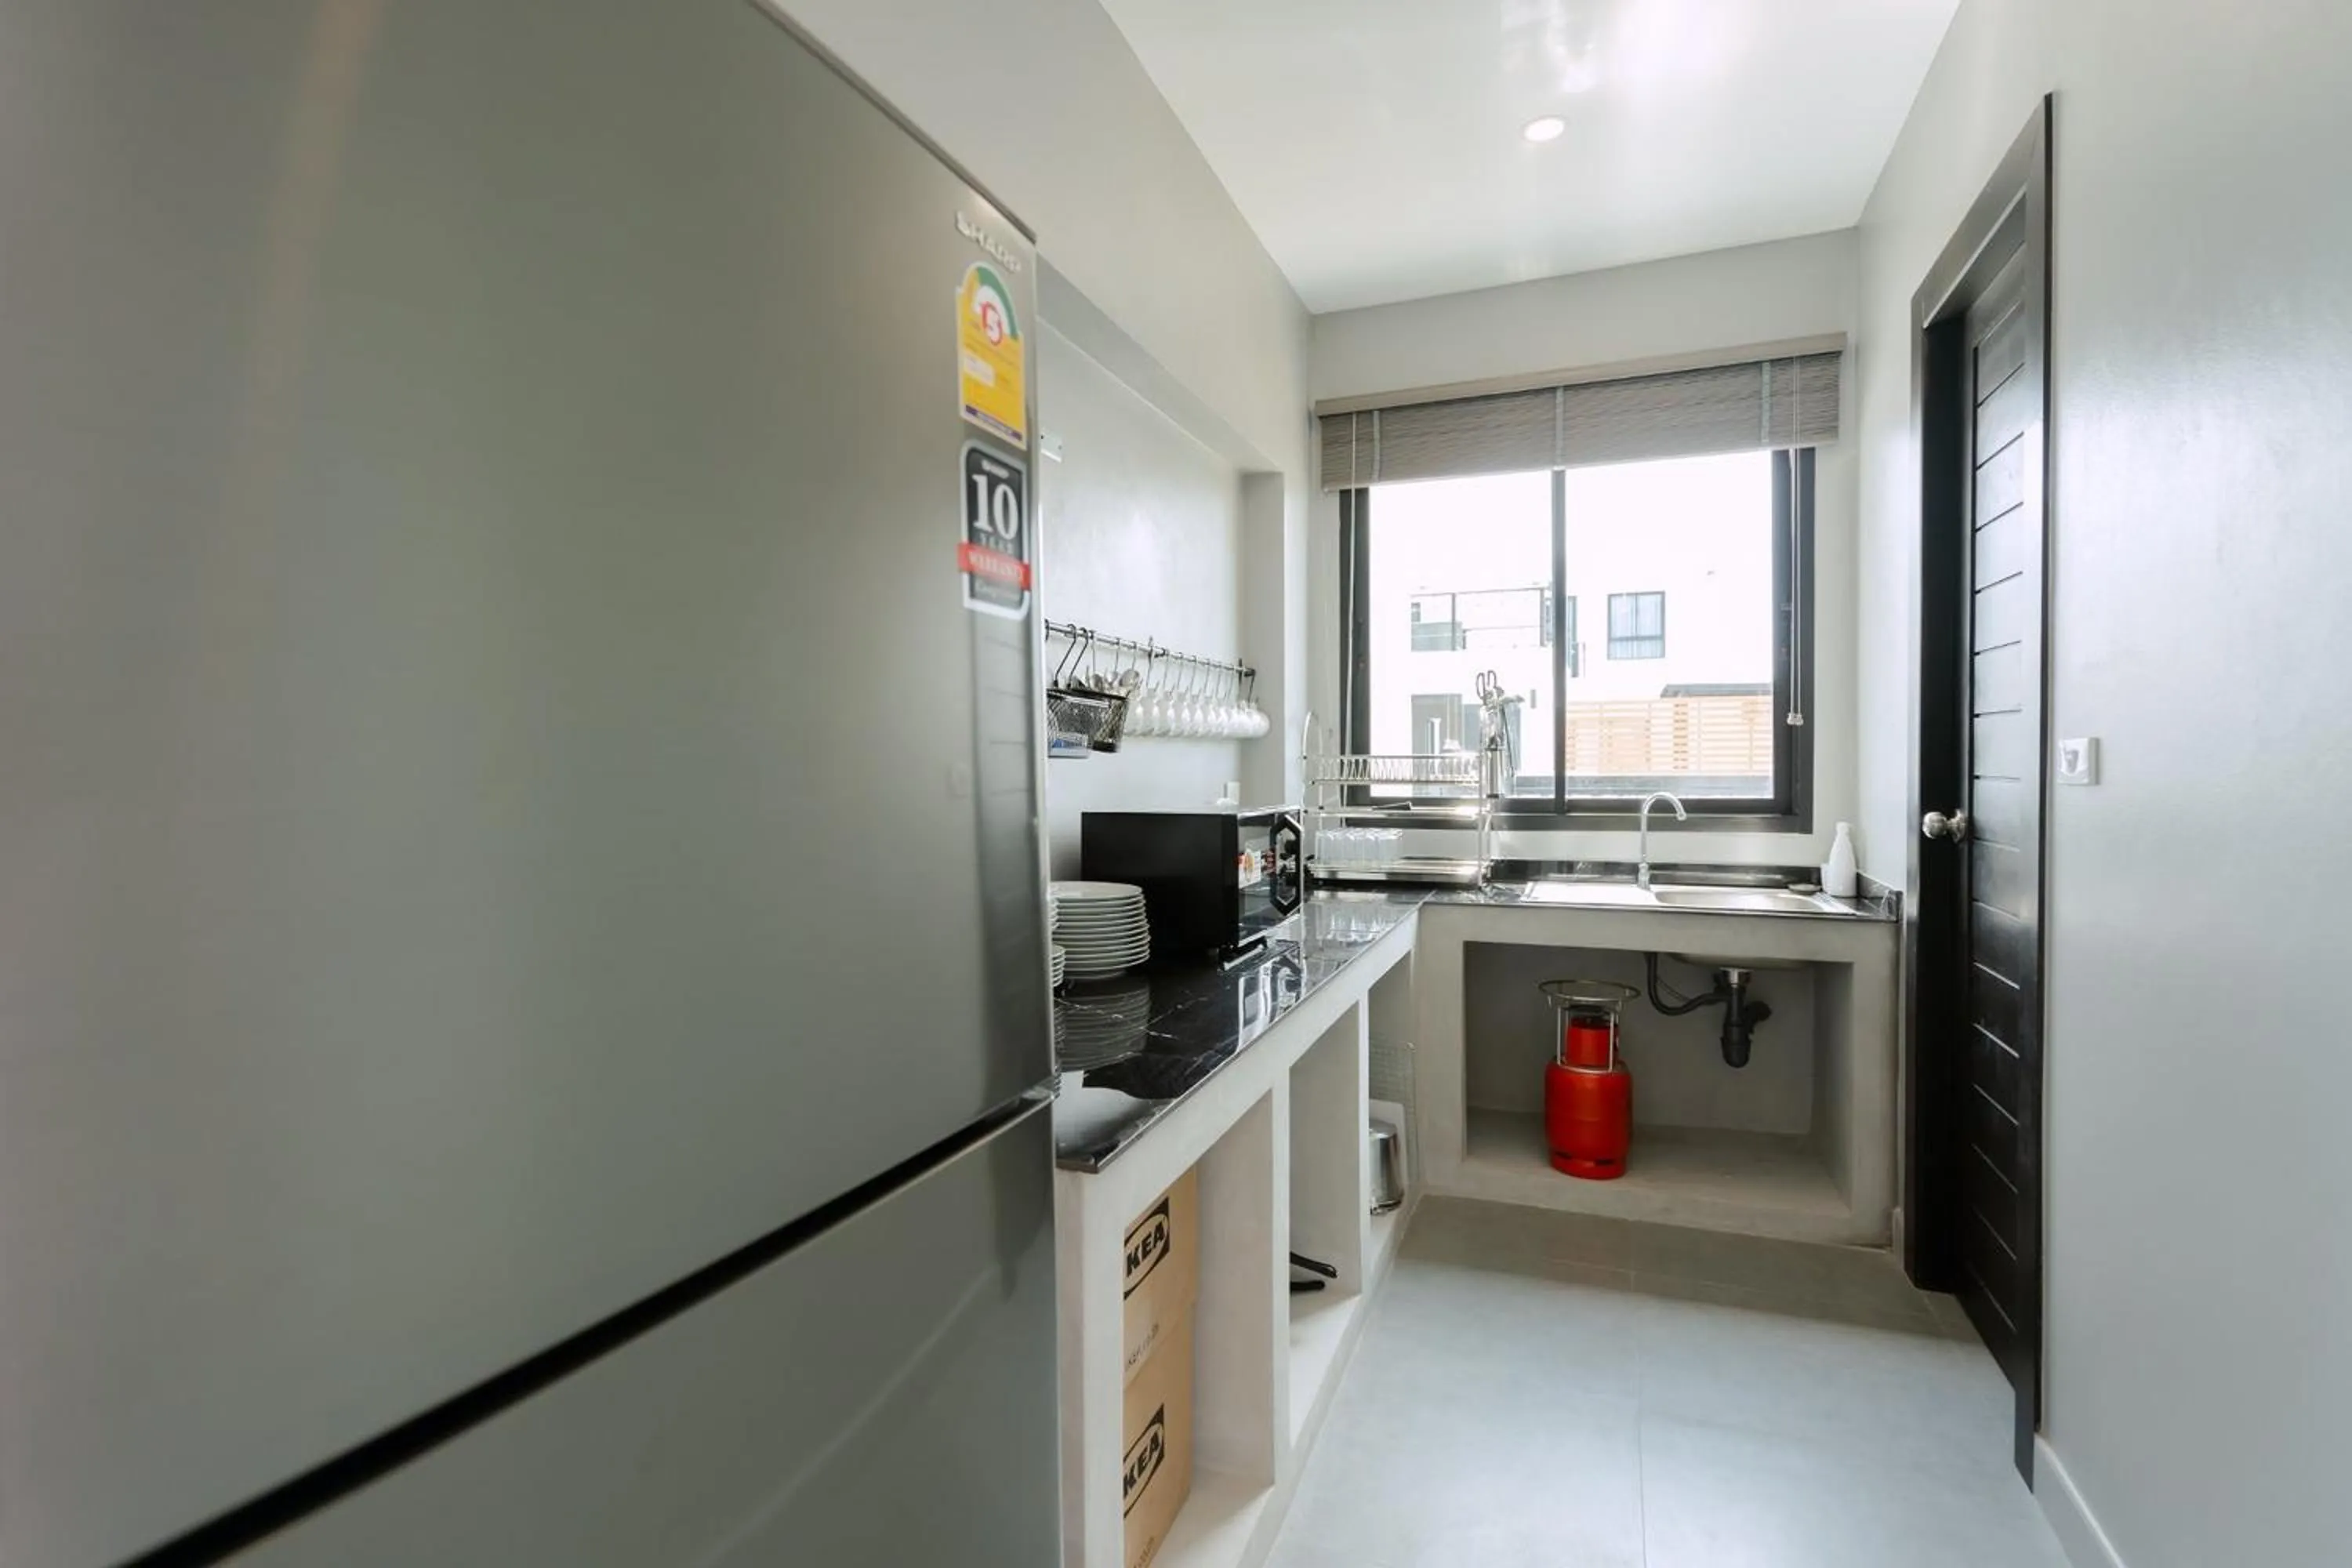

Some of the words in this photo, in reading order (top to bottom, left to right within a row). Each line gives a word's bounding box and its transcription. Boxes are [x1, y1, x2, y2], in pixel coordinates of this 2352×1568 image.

[971, 474, 1018, 540] 10
[1126, 1221, 1165, 1278] KEA
[1123, 1430, 1160, 1499] KEA
